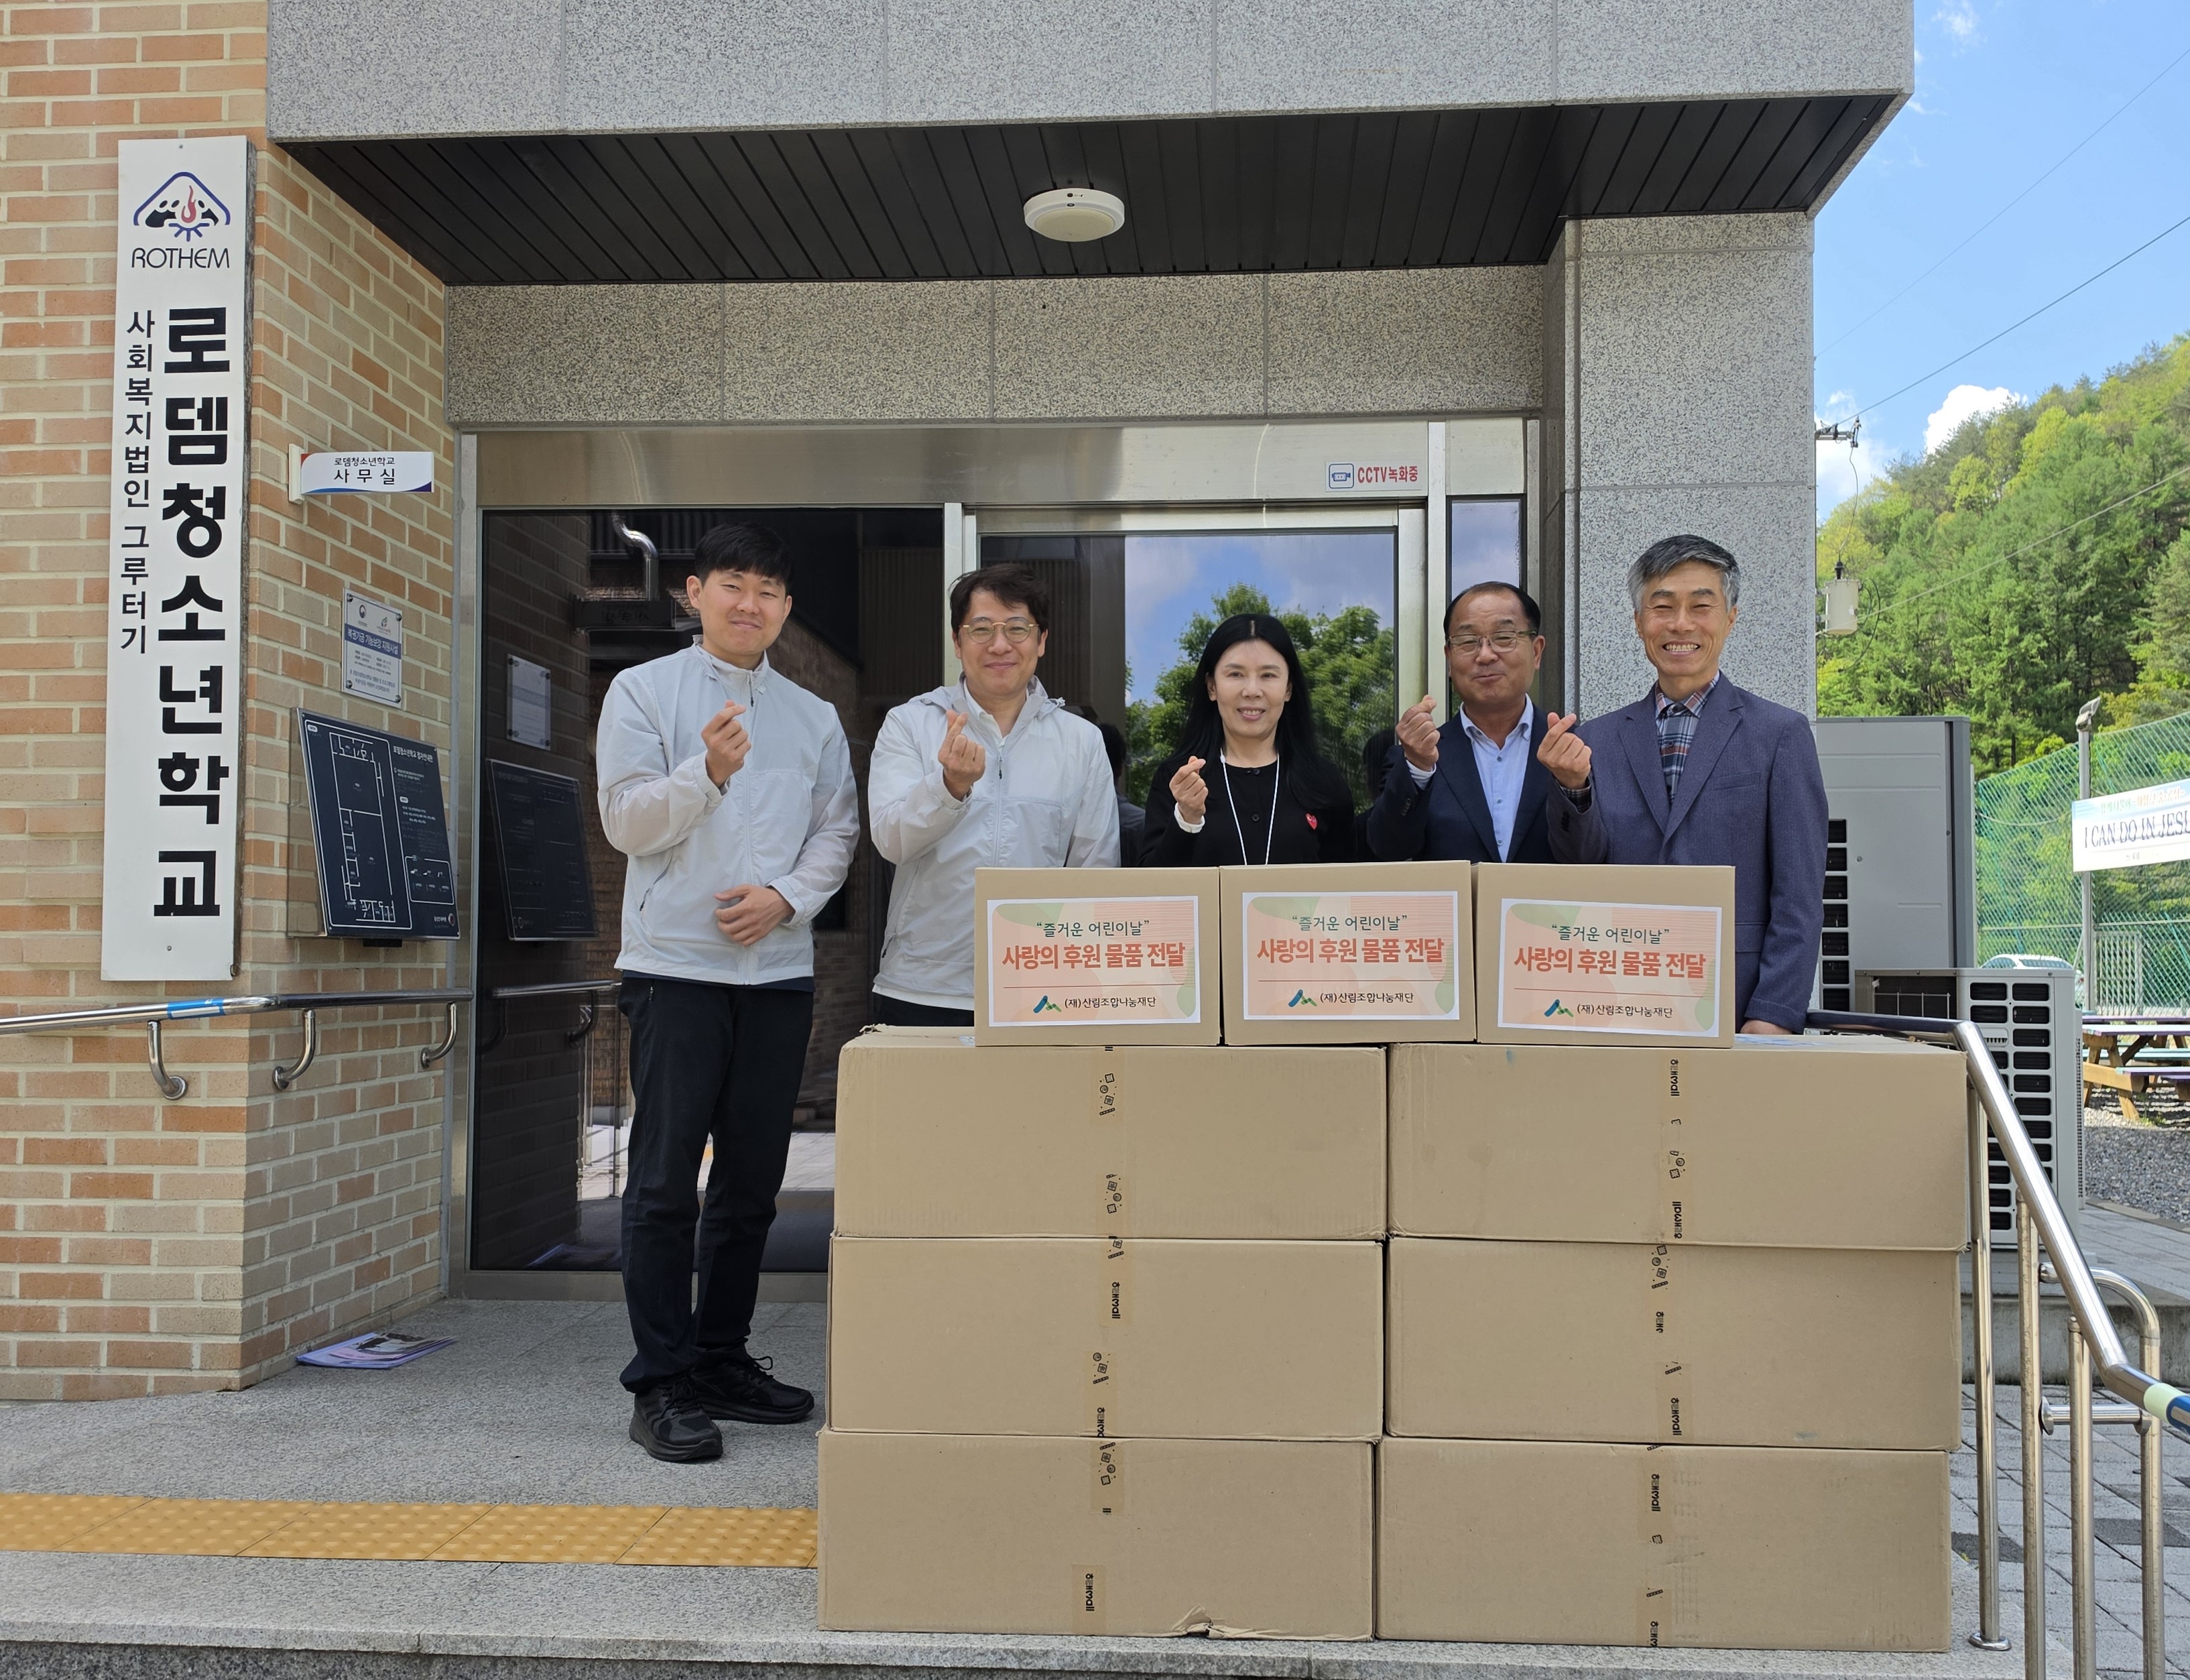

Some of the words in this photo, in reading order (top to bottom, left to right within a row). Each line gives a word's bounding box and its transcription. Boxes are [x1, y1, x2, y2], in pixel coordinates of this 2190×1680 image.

[131, 247, 230, 269] ROTHEM
[123, 310, 156, 508] 사회복지법인
[334, 457, 396, 467] 로뎀청소년학교
[121, 526, 149, 654] 그루터기
[154, 306, 230, 916] 로뎀청소년학교
[2085, 827, 2088, 848] I
[2091, 823, 2116, 847] CAN
[2120, 819, 2138, 843] DO
[2141, 816, 2155, 841] IN
[1001, 944, 1058, 970] 사랑의
[1063, 943, 1101, 969] 후원
[1105, 943, 1144, 968] 물품
[1147, 942, 1186, 967] 전달
[1256, 938, 1314, 963] 사랑의
[1319, 938, 1357, 963] 후원
[1361, 938, 1400, 963] 물품
[1404, 937, 1445, 963] 전달
[1514, 946, 1573, 973] 사랑의
[1577, 949, 1617, 975] 후원
[1621, 951, 1661, 977] 물품
[1665, 953, 1706, 979] 전달
